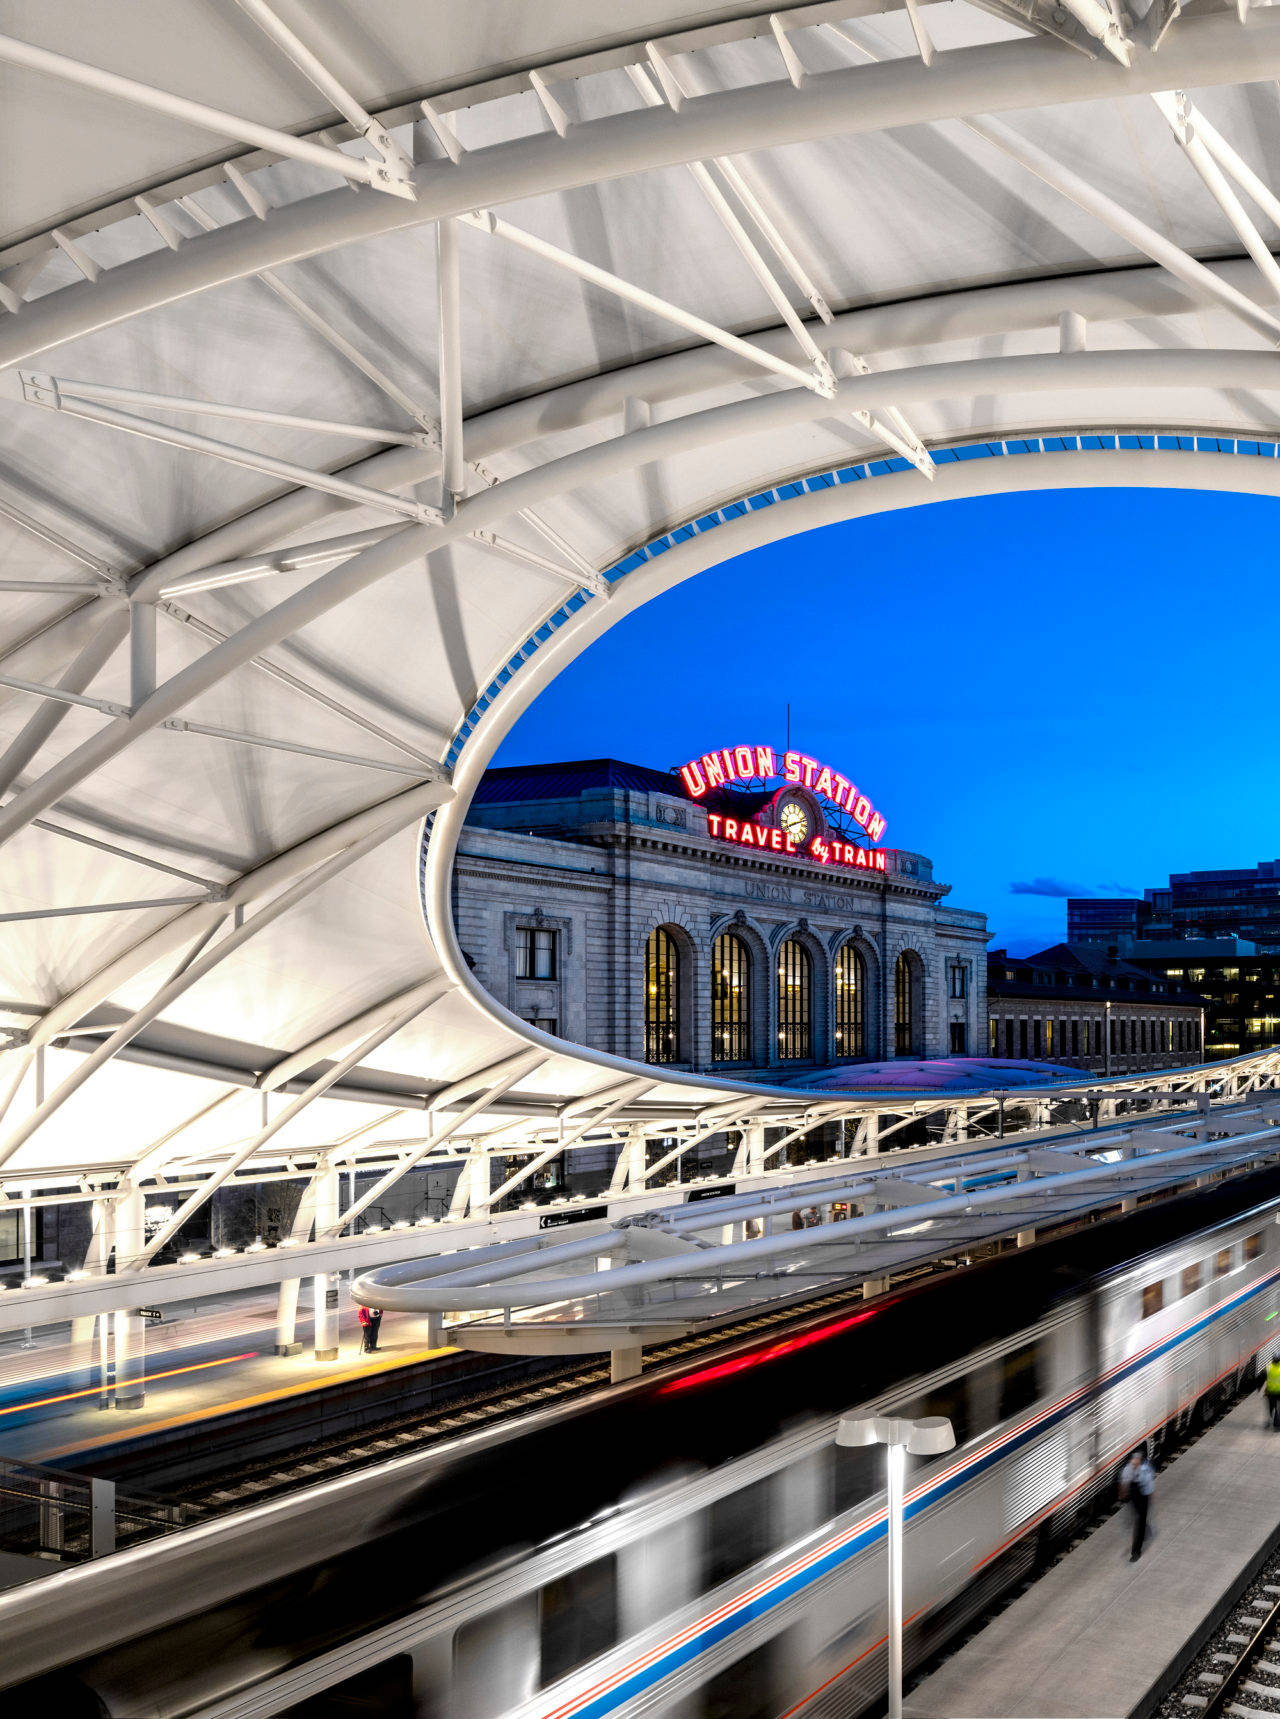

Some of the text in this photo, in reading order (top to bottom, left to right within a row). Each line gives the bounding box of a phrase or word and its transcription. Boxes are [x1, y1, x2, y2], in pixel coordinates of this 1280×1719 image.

[681, 746, 886, 843] UNION STATION
[708, 814, 886, 871] TRAVEL by TRAIN
[744, 881, 855, 912] UNION STATION
